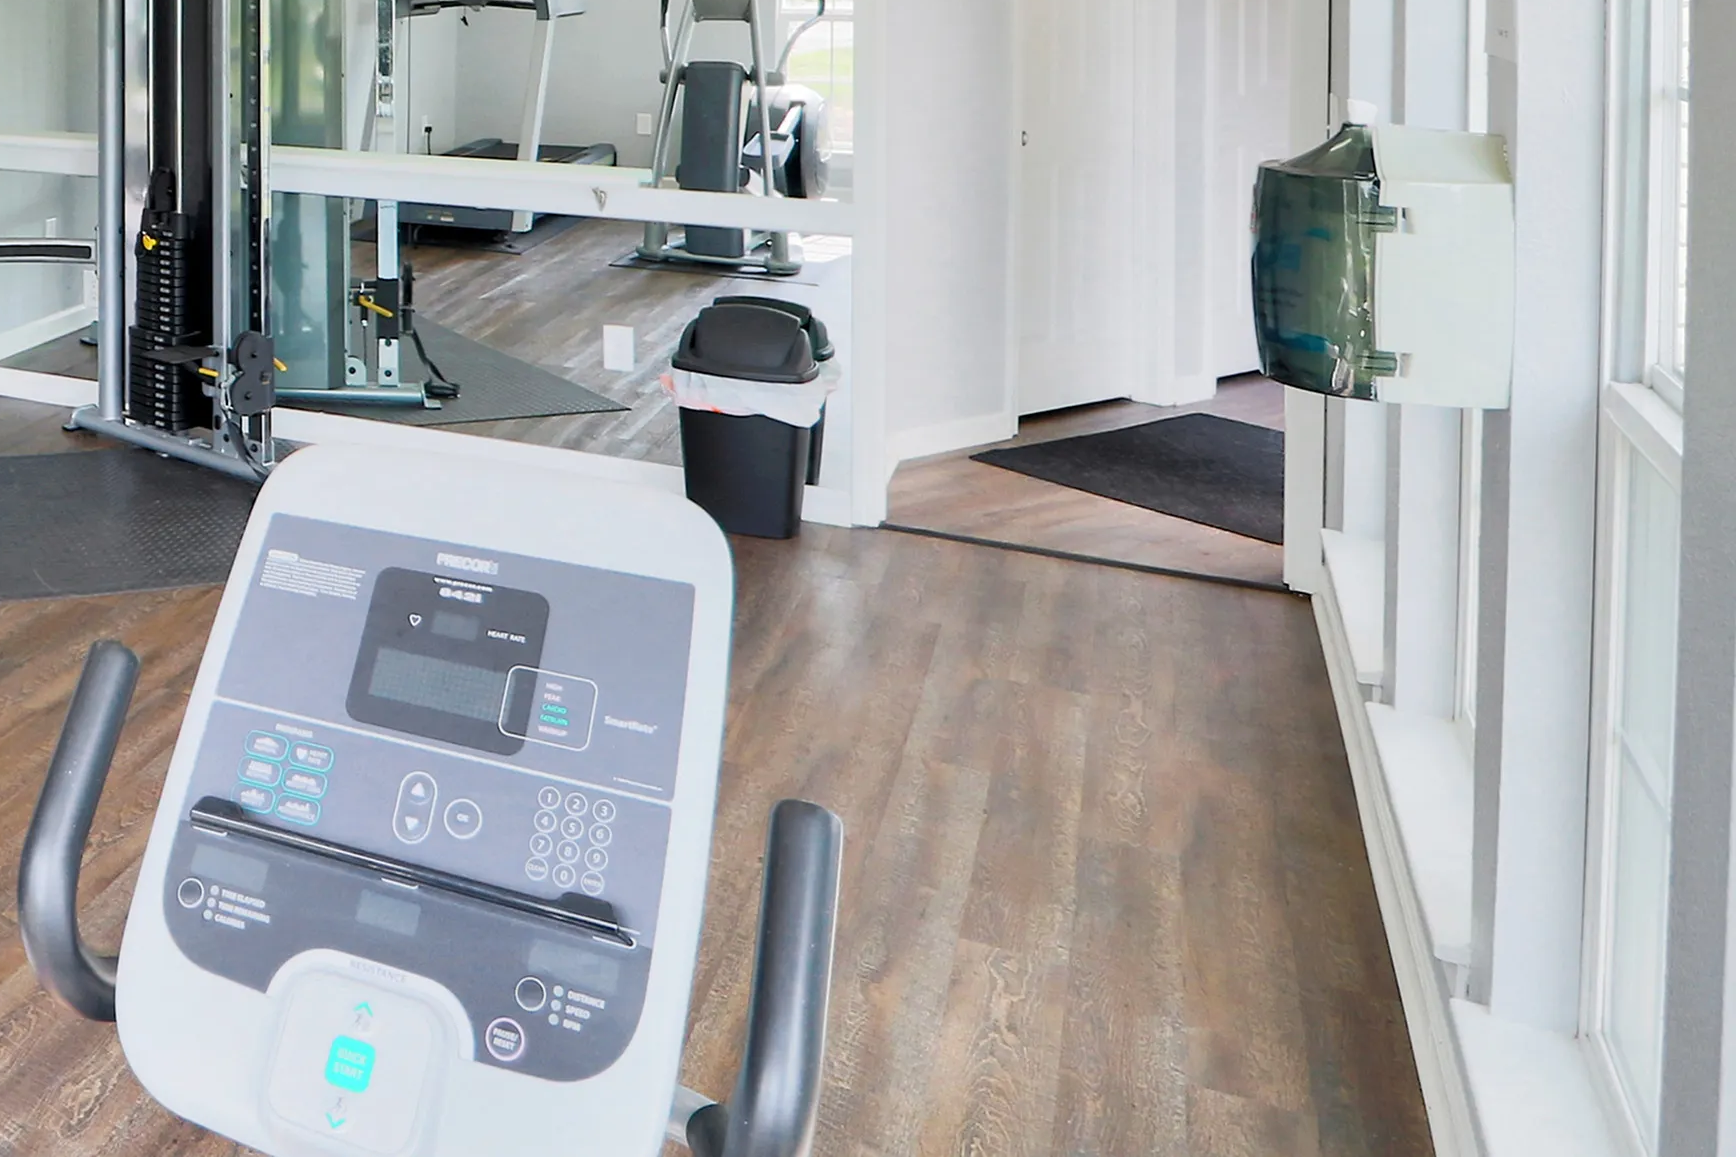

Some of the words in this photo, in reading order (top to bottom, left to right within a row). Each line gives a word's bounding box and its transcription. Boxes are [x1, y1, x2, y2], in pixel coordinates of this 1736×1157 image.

[546, 793, 552, 803] 1
[572, 799, 581, 810] 2
[600, 805, 608, 817] 3
[540, 816, 549, 827] 4
[568, 822, 576, 833] 5
[596, 828, 605, 840] 6
[537, 839, 545, 850] 7
[564, 846, 572, 857] 8
[592, 852, 601, 864] 9
[560, 870, 568, 882] 0
